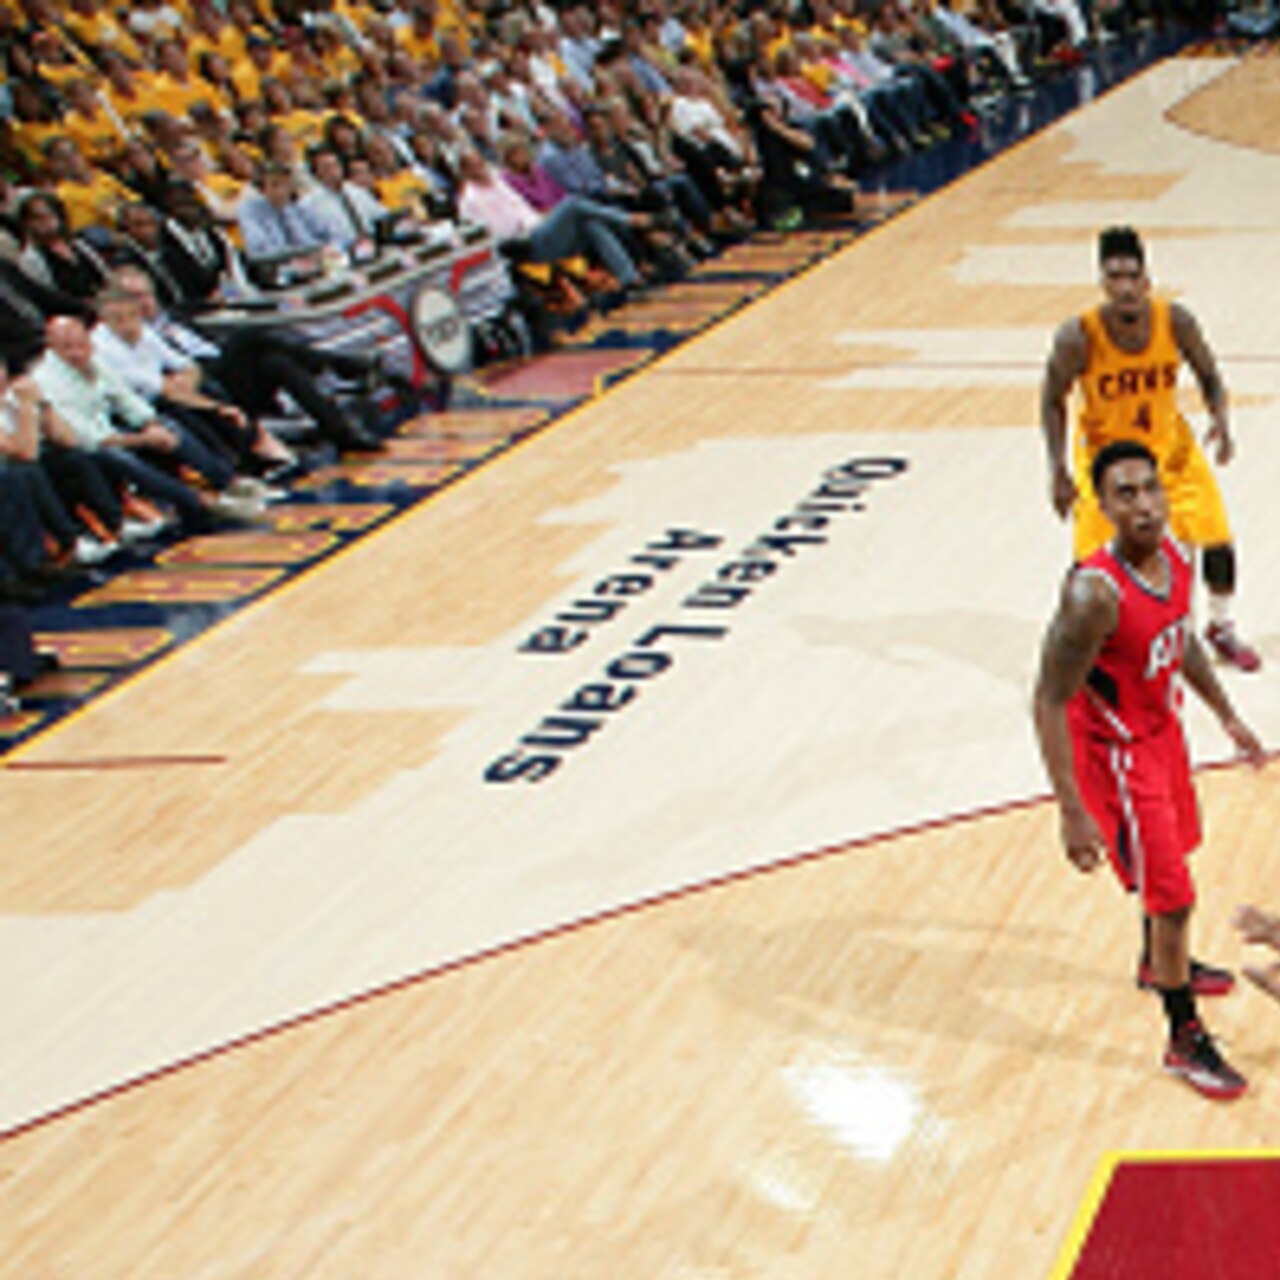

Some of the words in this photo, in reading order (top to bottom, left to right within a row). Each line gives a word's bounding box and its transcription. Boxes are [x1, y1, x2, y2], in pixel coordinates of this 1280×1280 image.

[1097, 362, 1177, 400] CAVS
[1131, 401, 1152, 433] 4
[517, 528, 724, 653] Arena
[682, 457, 909, 608] Quicken
[484, 625, 730, 782] Loans
